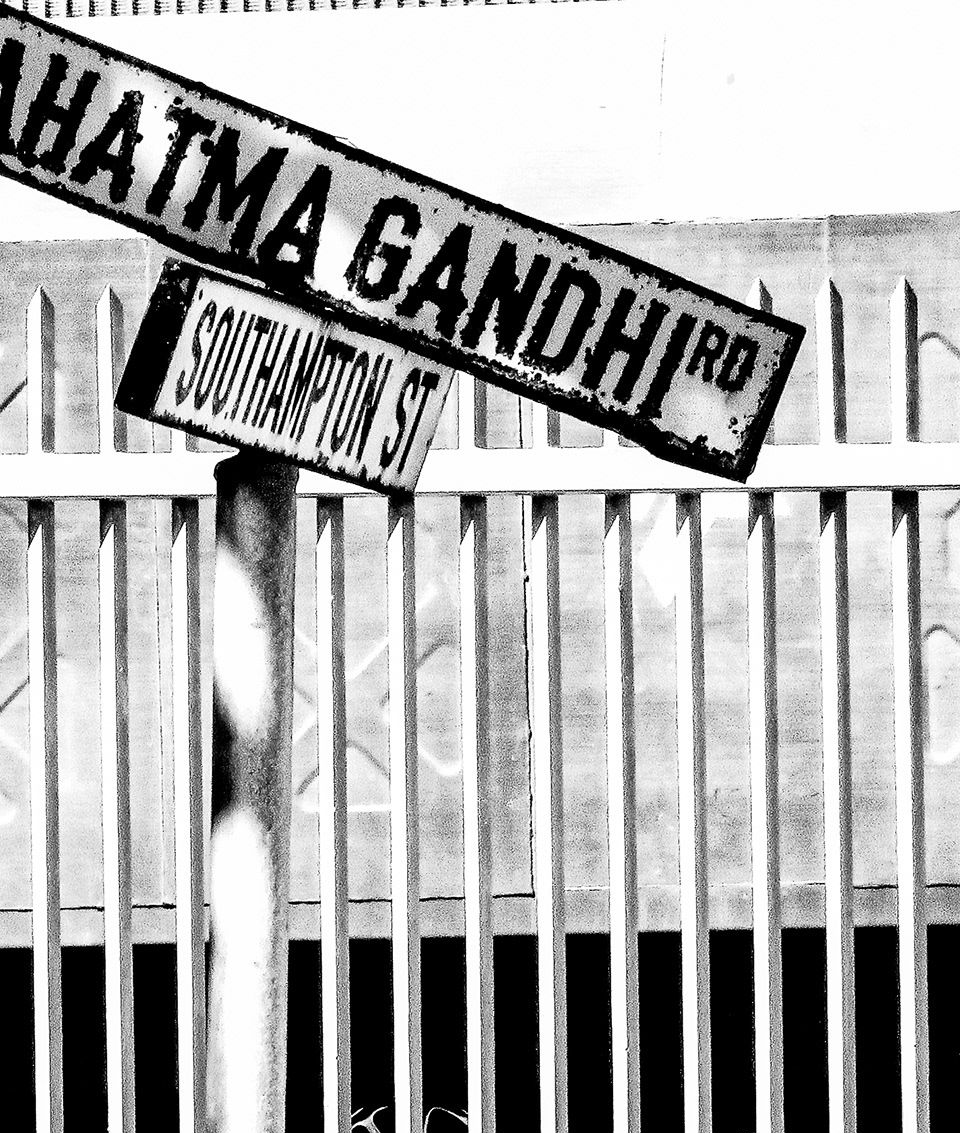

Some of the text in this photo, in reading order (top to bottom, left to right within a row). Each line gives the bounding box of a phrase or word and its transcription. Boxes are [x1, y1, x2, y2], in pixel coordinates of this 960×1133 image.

[175, 300, 441, 475] SOUTHAMPTON ST
[343, 195, 698, 418] GANDHI
[687, 320, 760, 393] RD
